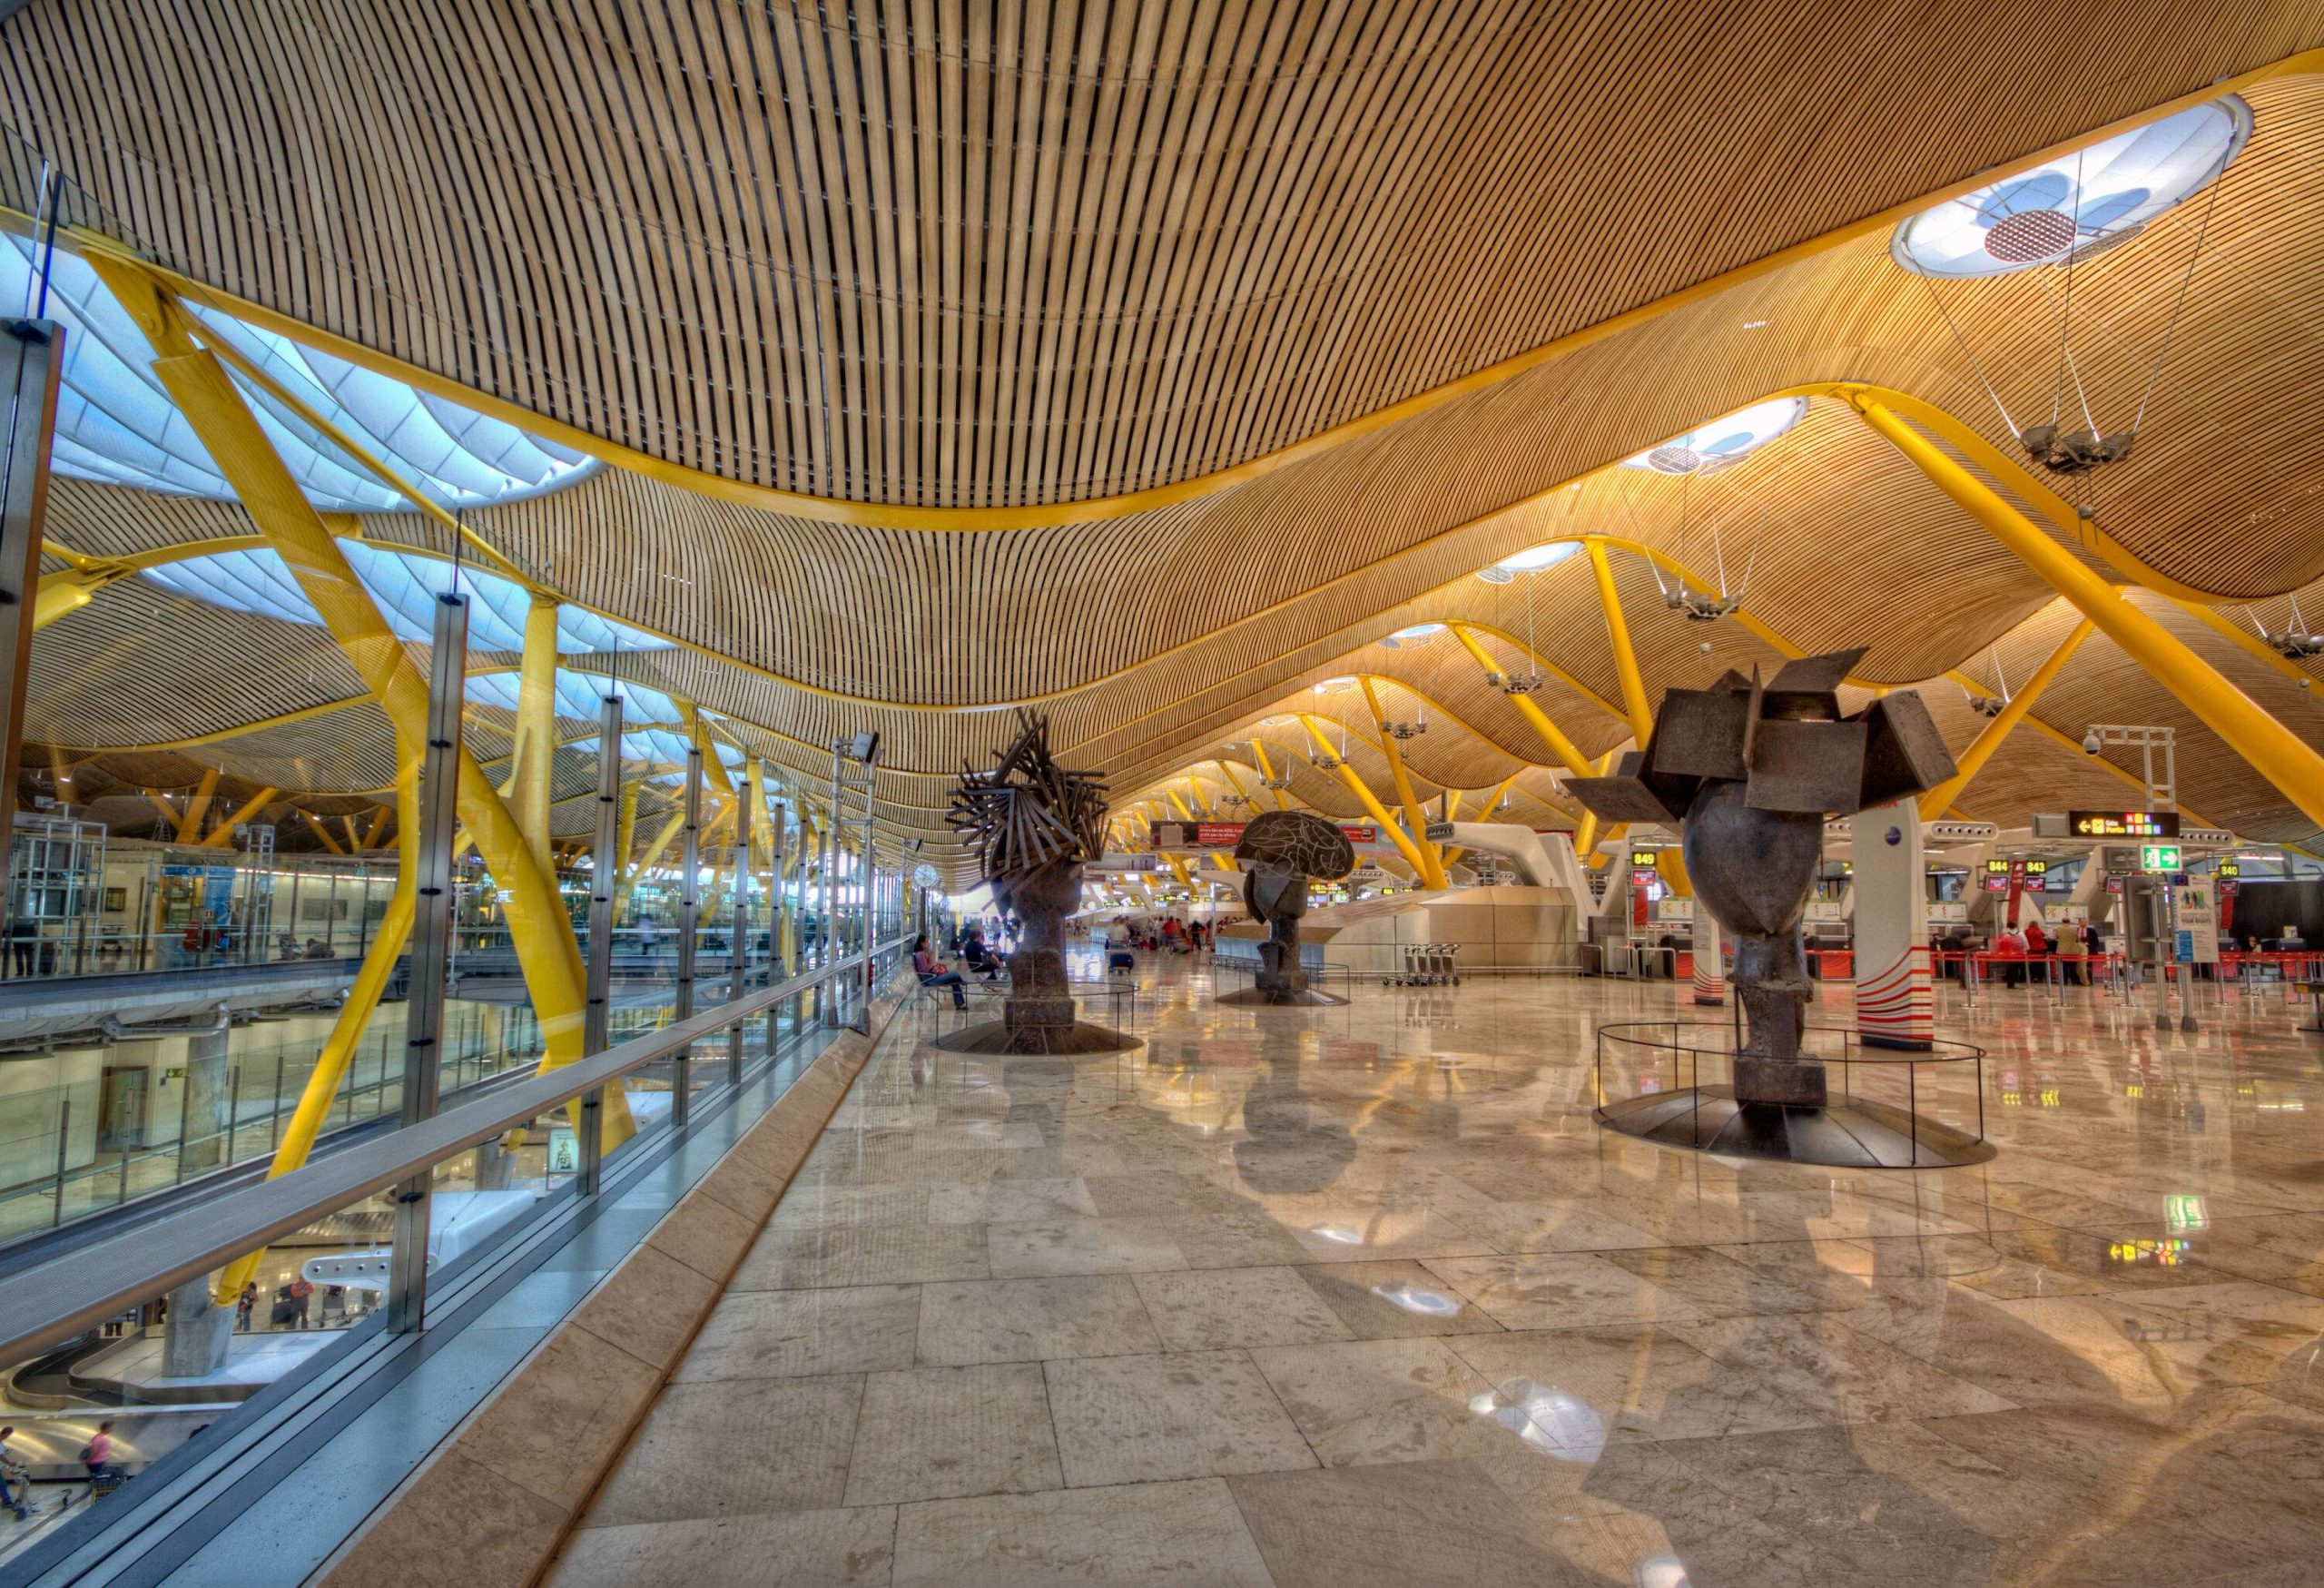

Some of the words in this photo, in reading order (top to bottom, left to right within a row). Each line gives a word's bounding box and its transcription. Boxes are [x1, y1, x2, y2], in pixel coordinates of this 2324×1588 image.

[1634, 853, 1655, 864] 849
[1989, 861, 2008, 872] 844
[2026, 862, 2045, 873] 843
